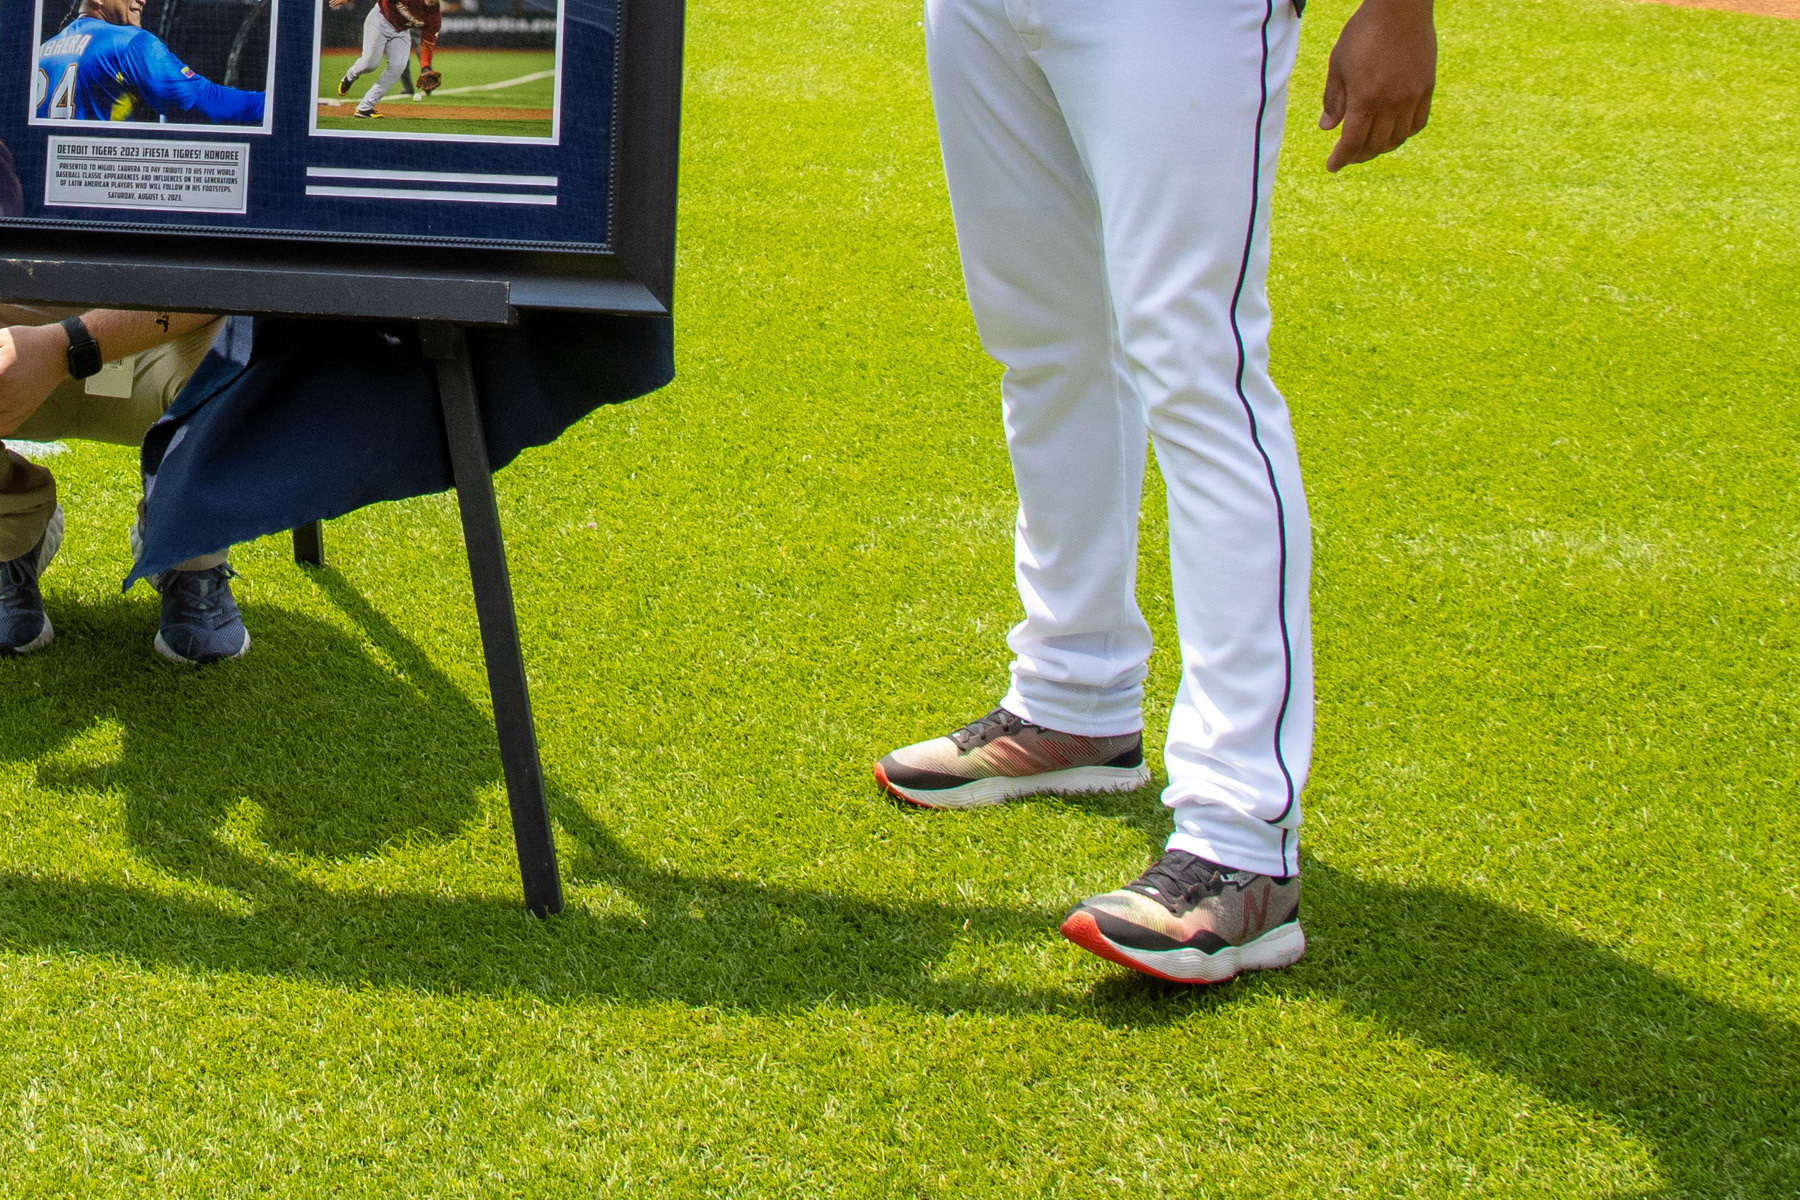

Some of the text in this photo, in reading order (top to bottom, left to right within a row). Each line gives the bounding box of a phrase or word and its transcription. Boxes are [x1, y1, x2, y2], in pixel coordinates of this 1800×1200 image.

[57, 144, 88, 155] DETROIT
[92, 146, 117, 156] TIGERS
[120, 147, 139, 157] 2023
[173, 149, 201, 159] TIGRES!
[204, 150, 239, 160] HONOREE
[59, 162, 88, 171] PRESENTED
[89, 163, 96, 171] TO
[56, 170, 80, 178] BASEBALL
[84, 180, 109, 188] AMERICAN
[111, 181, 133, 189] PLAYERS
